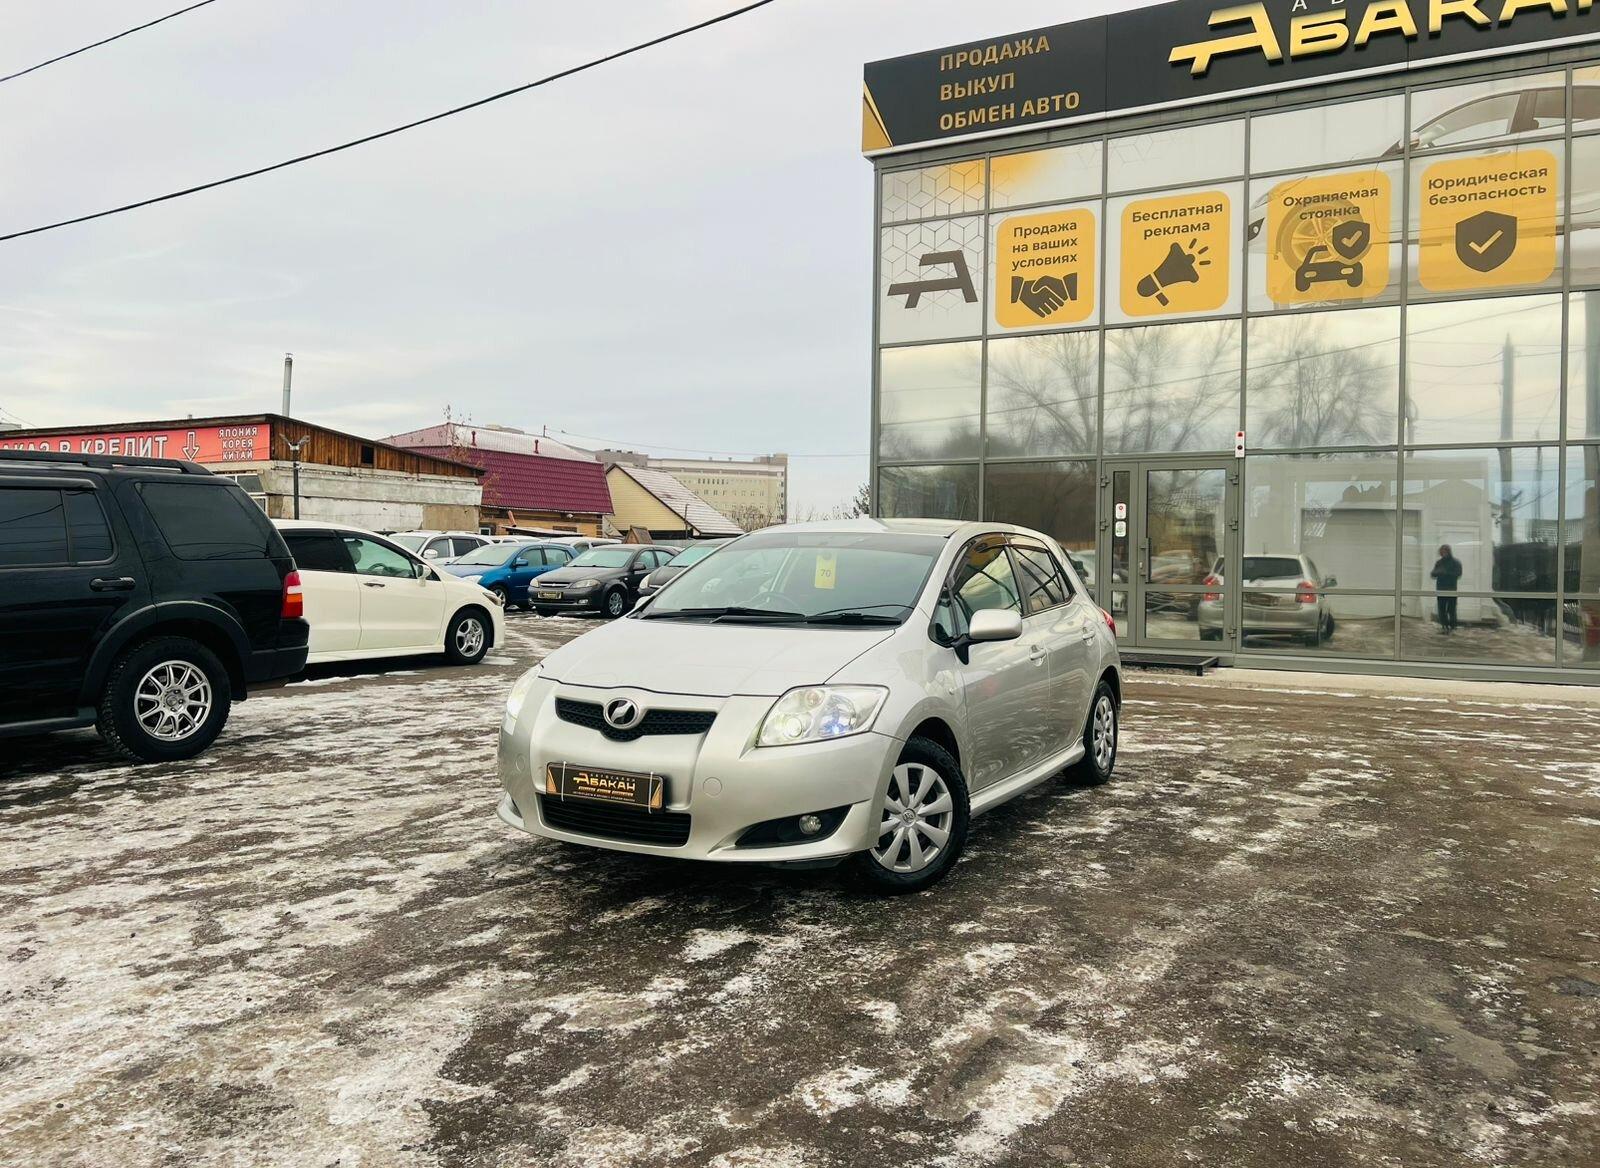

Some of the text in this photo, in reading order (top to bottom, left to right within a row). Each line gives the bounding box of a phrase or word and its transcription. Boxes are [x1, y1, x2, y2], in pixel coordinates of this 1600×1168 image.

[940, 35, 1050, 71] ПРОДАЖА
[940, 72, 1015, 101] ВЫКУП
[939, 91, 1080, 131] ОБМЕН АВТО
[1428, 167, 1548, 190] Юридическая
[1283, 187, 1378, 207] Охраняемая
[1429, 183, 1547, 206] безопасность
[1132, 203, 1223, 222] Бесплатная
[1299, 205, 1361, 221] стоянка
[1013, 221, 1077, 238] Продажа
[1143, 220, 1210, 240] реклама
[1012, 236, 1078, 253] на ваших
[1011, 252, 1078, 272] условиях
[218, 427, 258, 438] ЯПОНИЯ
[80, 435, 168, 460] КРЕДИТ
[222, 438, 253, 449] КОРЕЯ
[222, 448, 253, 460] КИТАЙ
[820, 568, 832, 578] 70
[573, 771, 636, 791] АБАКАН
